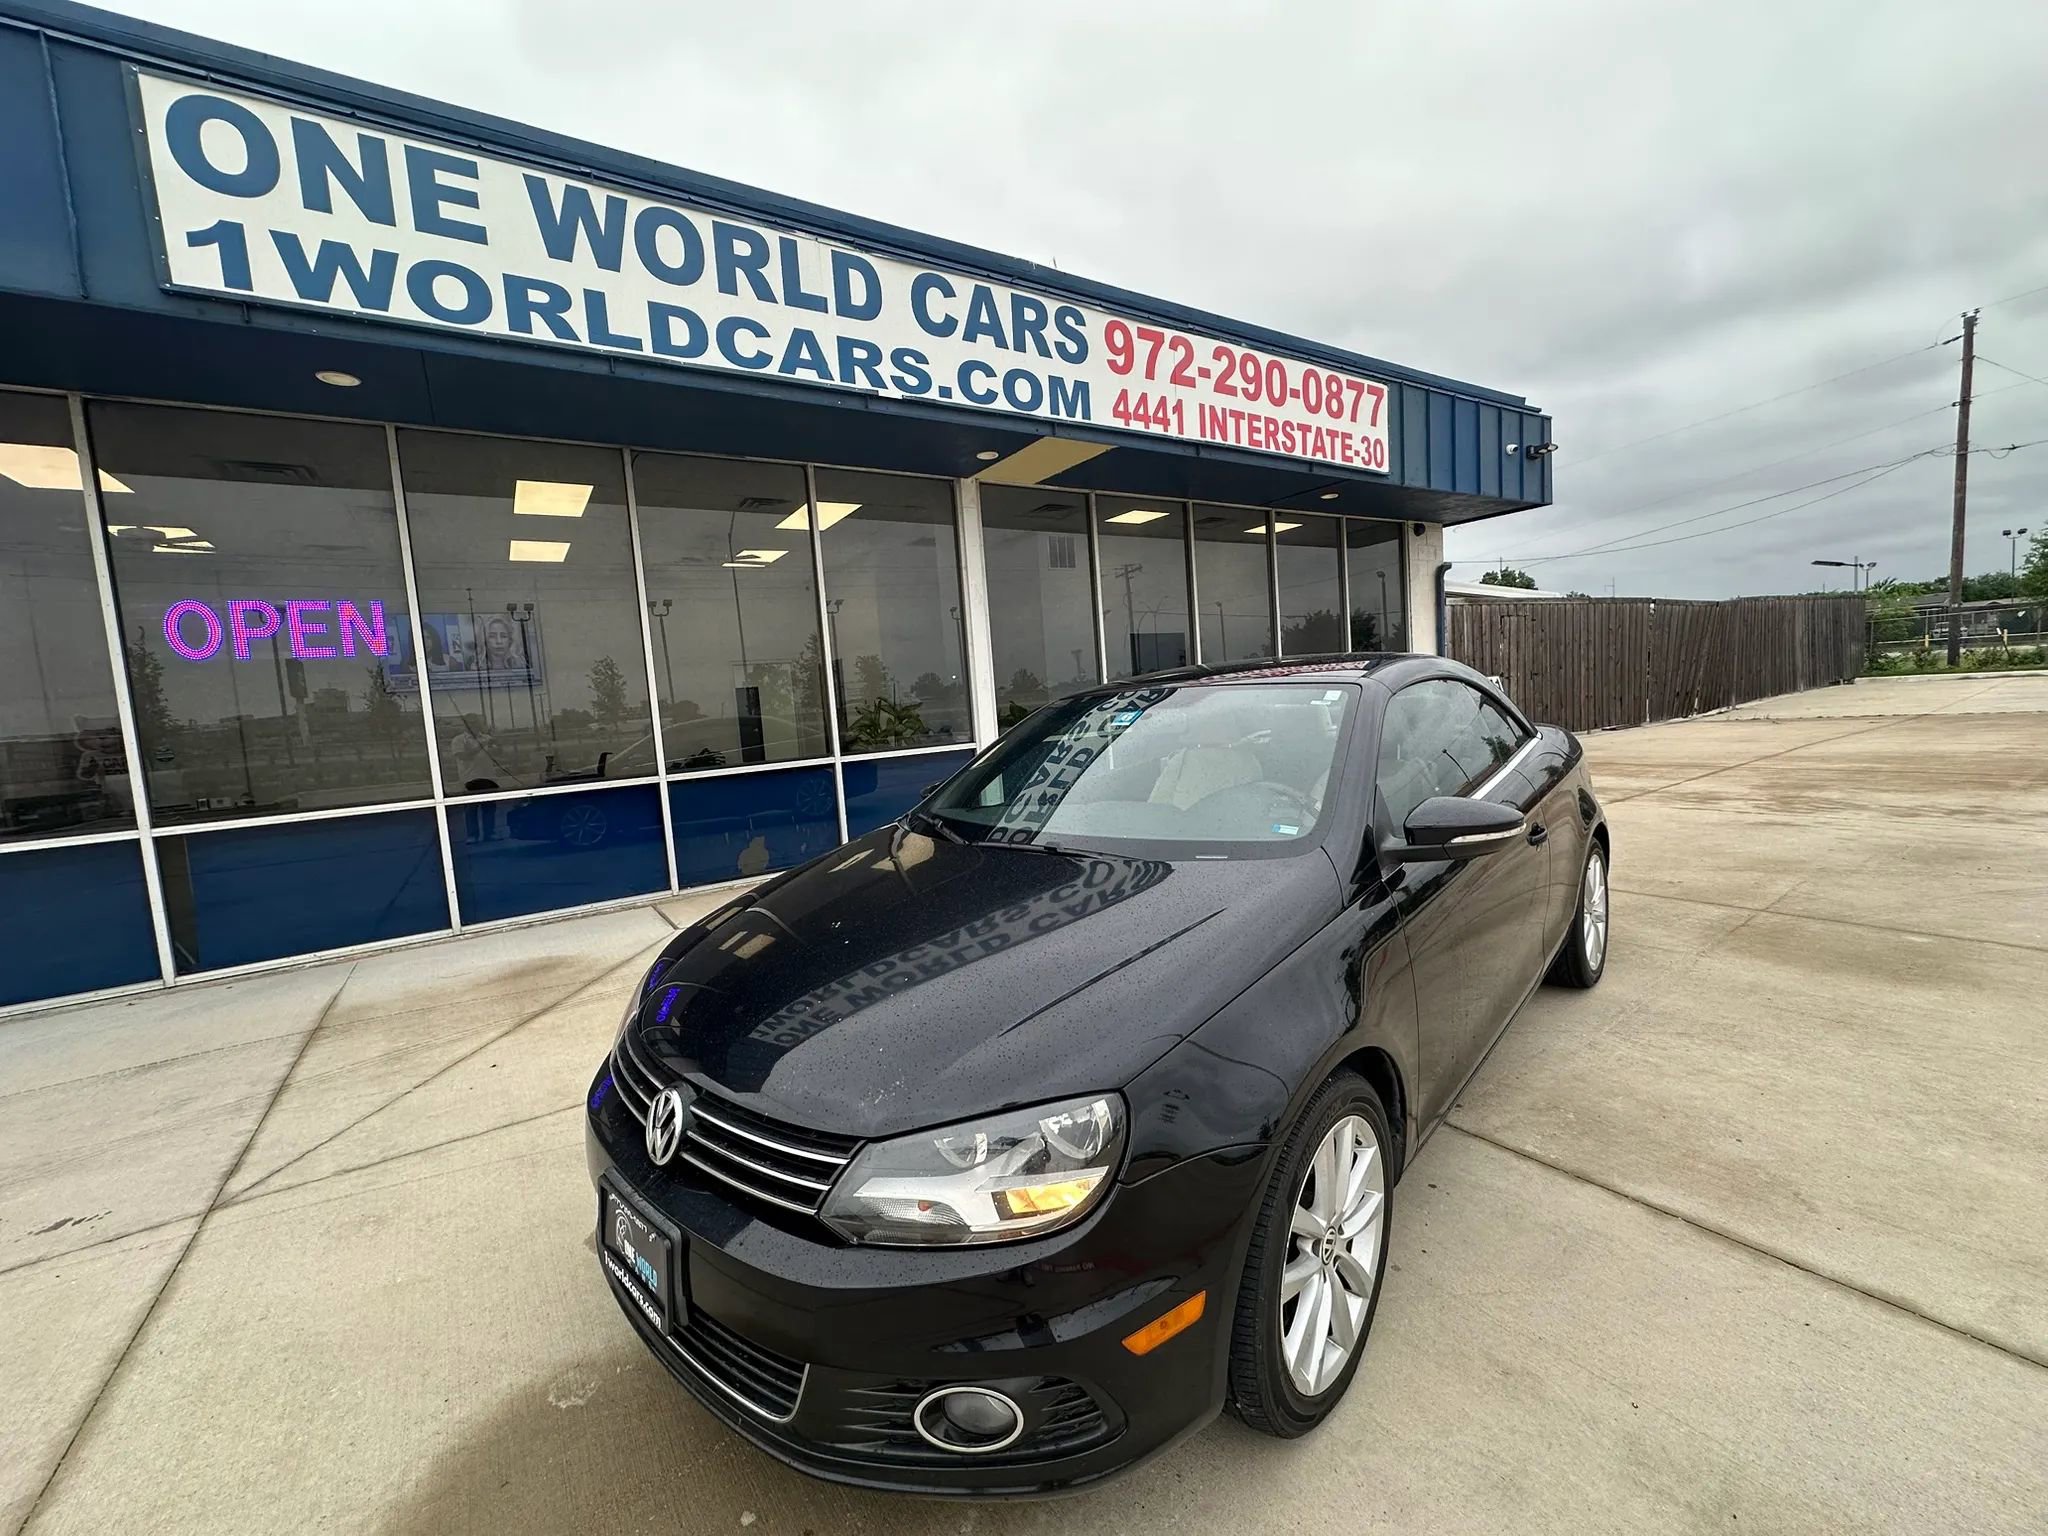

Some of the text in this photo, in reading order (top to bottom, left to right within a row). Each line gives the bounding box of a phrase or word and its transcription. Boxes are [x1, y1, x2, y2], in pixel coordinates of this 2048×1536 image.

[165, 94, 1089, 365] ONE WORLD CARS
[186, 219, 1092, 421] 1WORLDCARS.COM
[1104, 320, 1385, 428] 972-290-0877
[1112, 388, 1385, 469] 4441 INTERSTATE-30
[163, 599, 389, 661] OPEN
